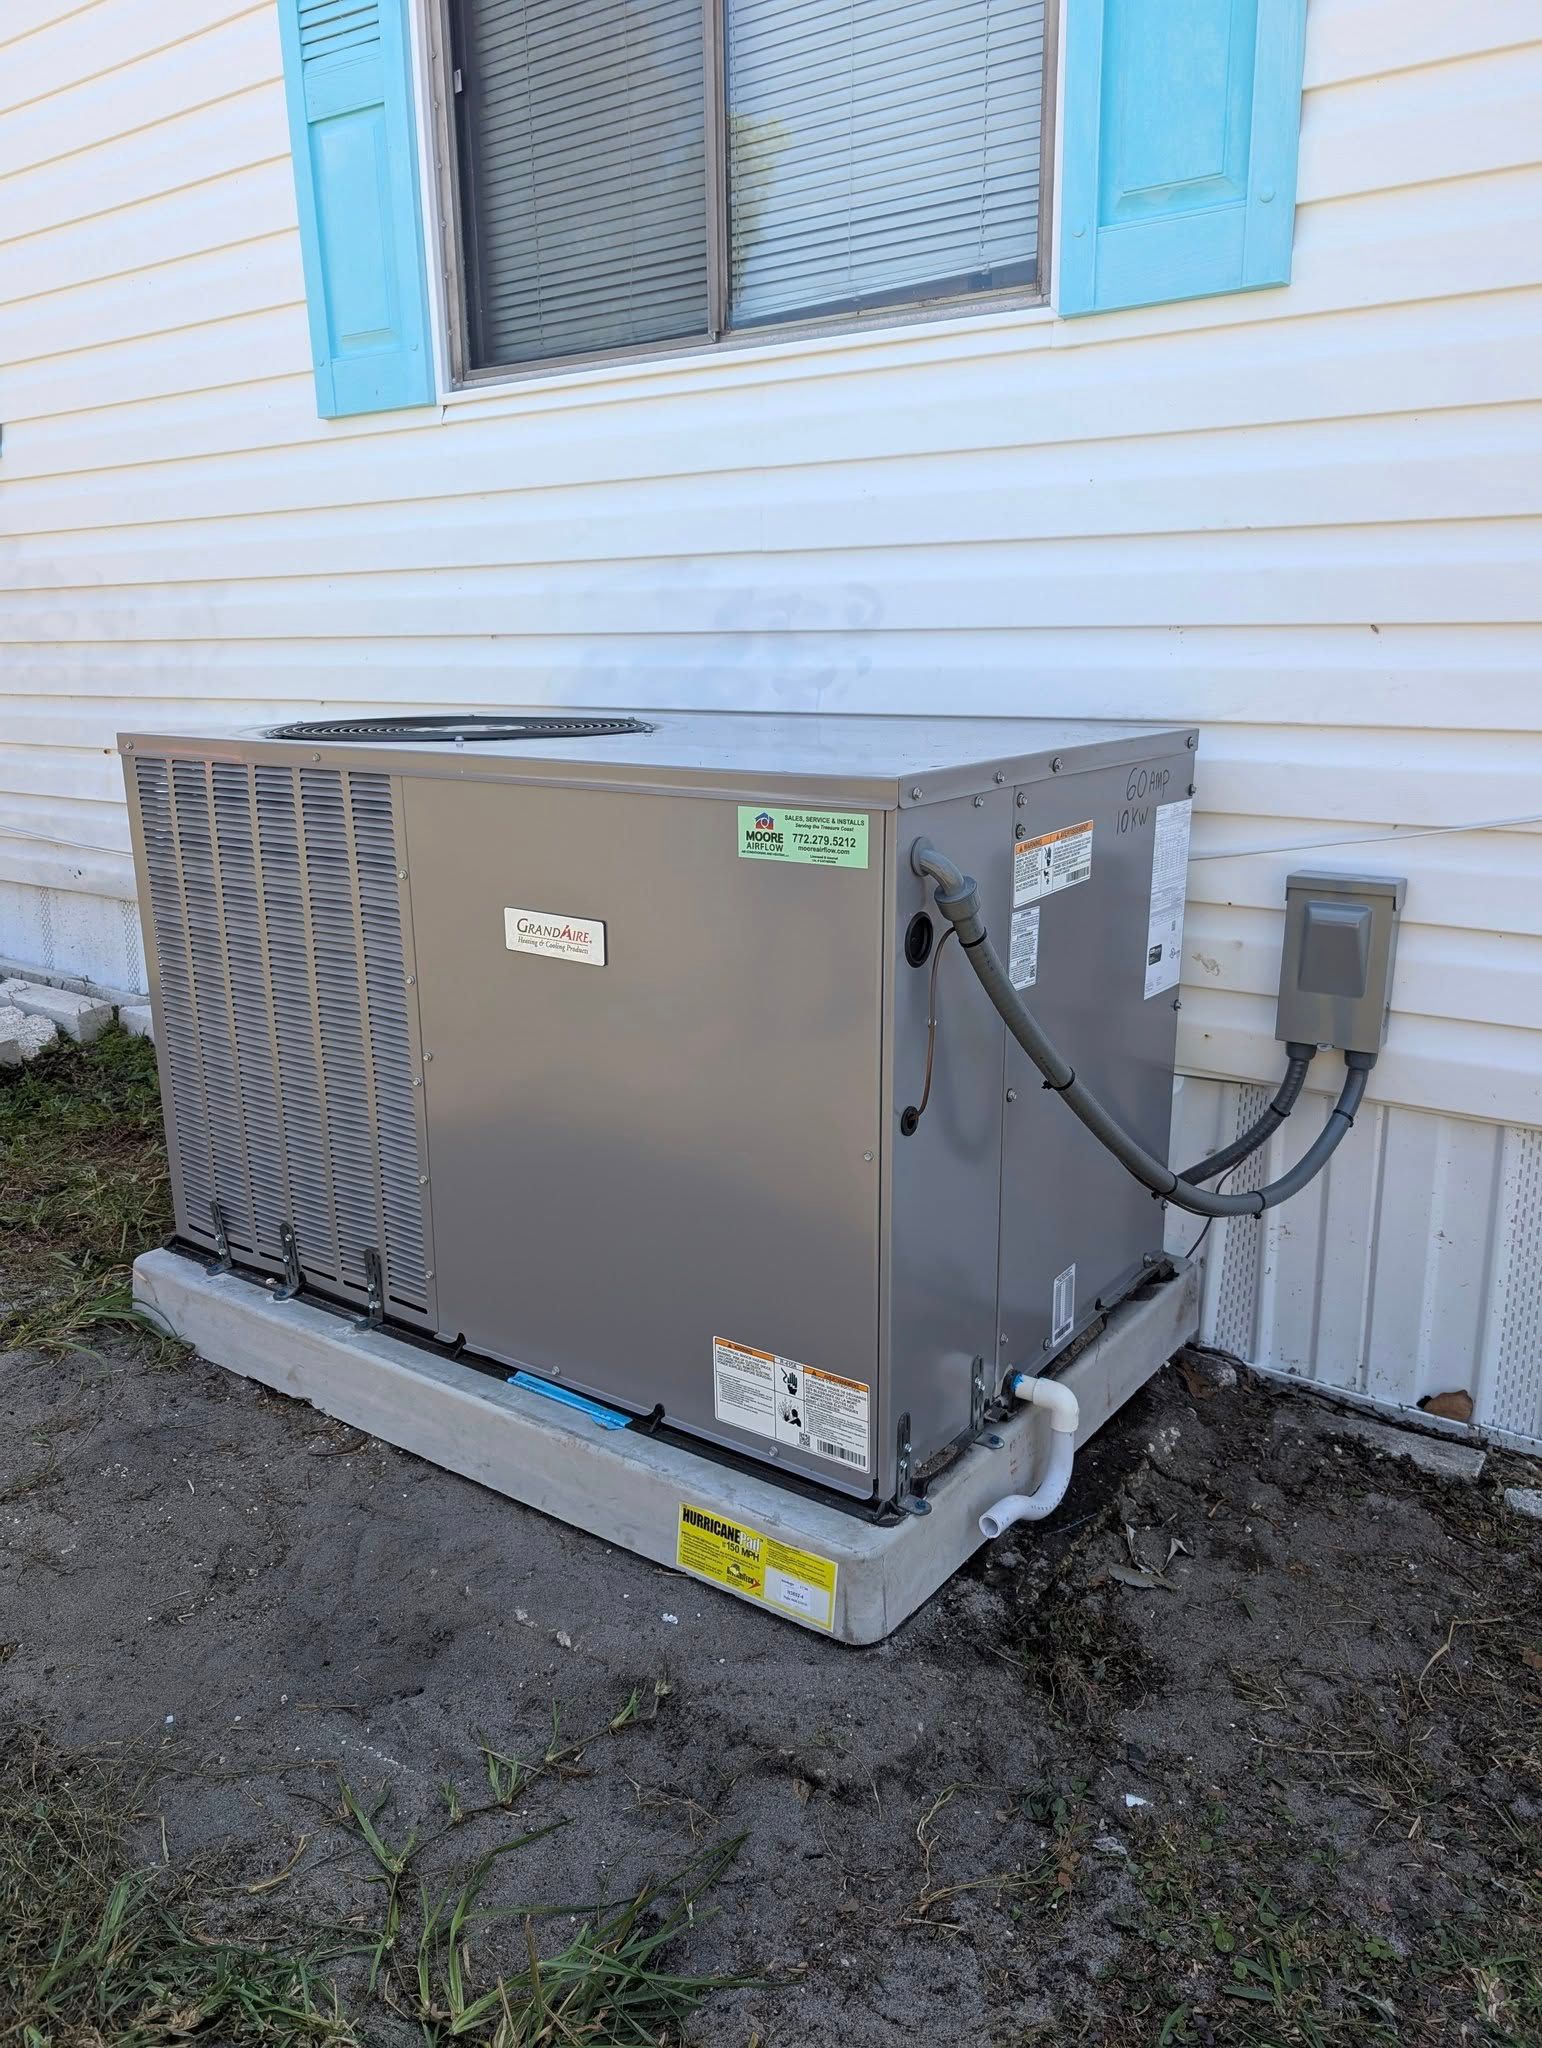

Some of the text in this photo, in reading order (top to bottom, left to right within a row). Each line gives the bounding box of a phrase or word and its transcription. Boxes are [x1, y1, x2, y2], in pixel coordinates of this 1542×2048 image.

[1126, 767, 1169, 801] 60 AMP
[784, 814, 804, 823] SALES,
[805, 816, 831, 825] SERVICE
[837, 819, 865, 827] INSTALLS
[746, 830, 783, 844] MOORE
[792, 833, 856, 848] 772.279.5212
[746, 841, 783, 853] AIRFLOW
[798, 845, 850, 855] mooreairflow.com
[518, 936, 538, 947] Heating
[545, 940, 566, 952] Cooling
[566, 945, 589, 954] Products
[726, 1542, 740, 1554] 150
[741, 1549, 760, 1562] MPH
